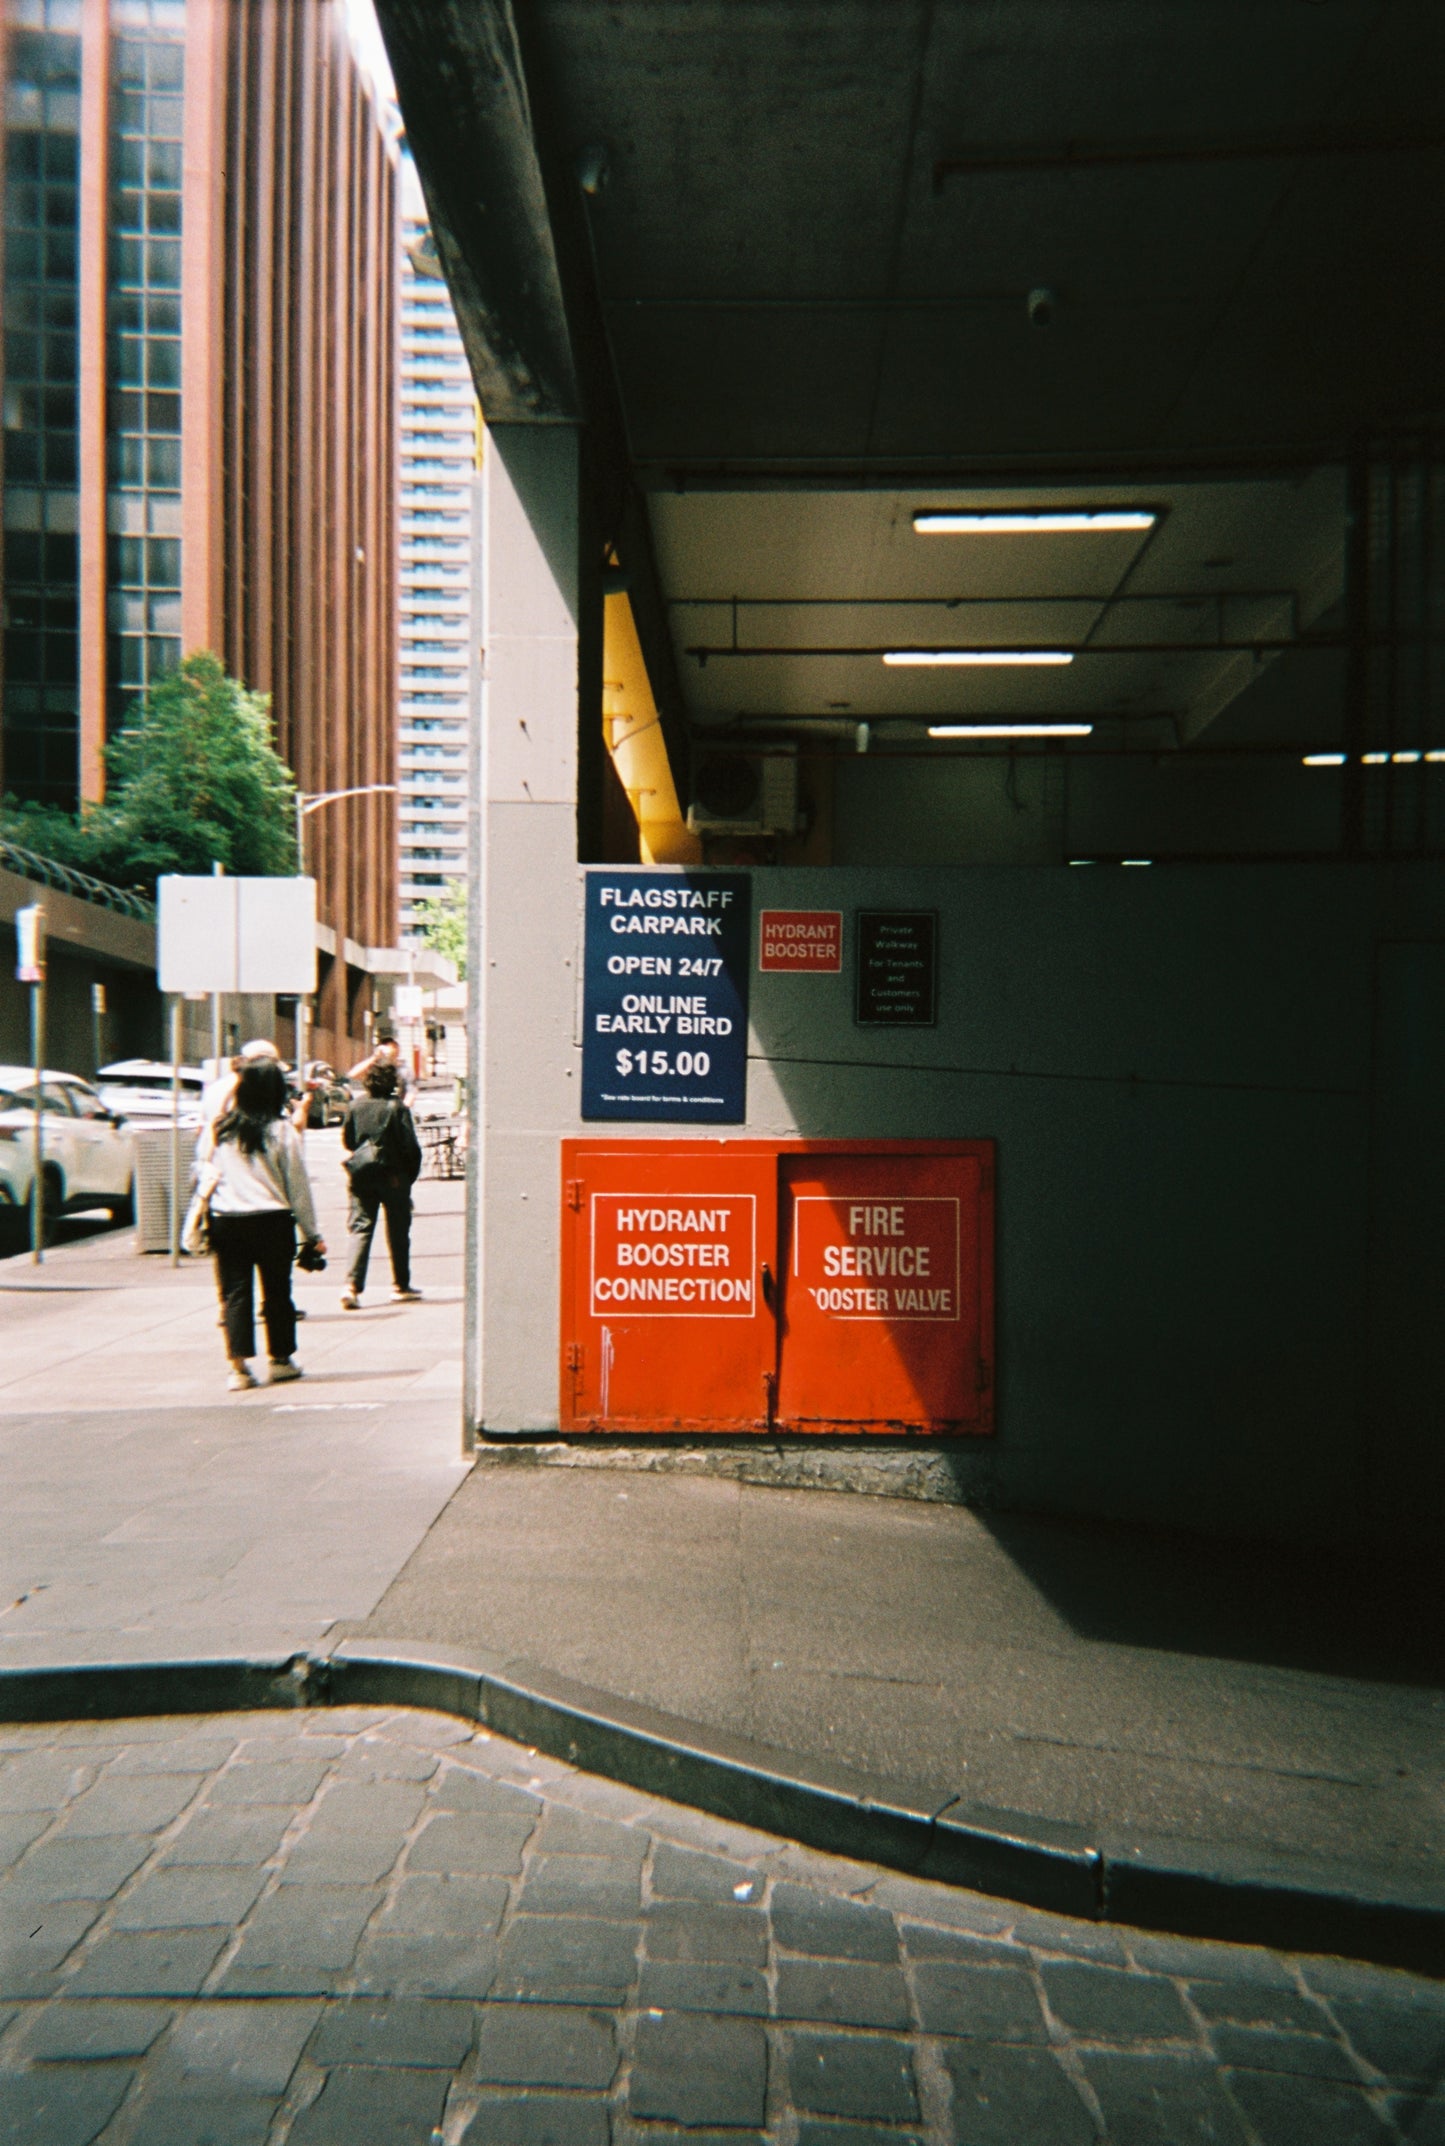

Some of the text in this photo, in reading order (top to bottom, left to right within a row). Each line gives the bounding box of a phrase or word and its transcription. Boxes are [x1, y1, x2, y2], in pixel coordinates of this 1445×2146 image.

[600, 888, 733, 909] FLAGSTAFF
[610, 916, 722, 935] CARPARK
[766, 924, 837, 939] HYDRANT
[880, 925, 913, 934] Private
[765, 943, 836, 959] BOOSTER
[875, 940, 918, 950] Walkway
[607, 956, 723, 977] OPEN 24/7
[869, 959, 924, 968] For Tenants
[887, 974, 905, 982] and
[871, 988, 920, 997] Customers
[622, 994, 707, 1015] ONLINE
[876, 1003, 914, 1014] use only
[596, 1015, 732, 1036] EARLY BIRD
[616, 1048, 710, 1077] $15.00
[617, 1209, 730, 1232] HYDRANT
[849, 1206, 905, 1236] FIRE
[617, 1243, 729, 1267] BOOSTER
[824, 1246, 930, 1277] SERVICE
[595, 1277, 751, 1302] CONNECTION
[809, 1288, 951, 1311] OOSTER VALVE
